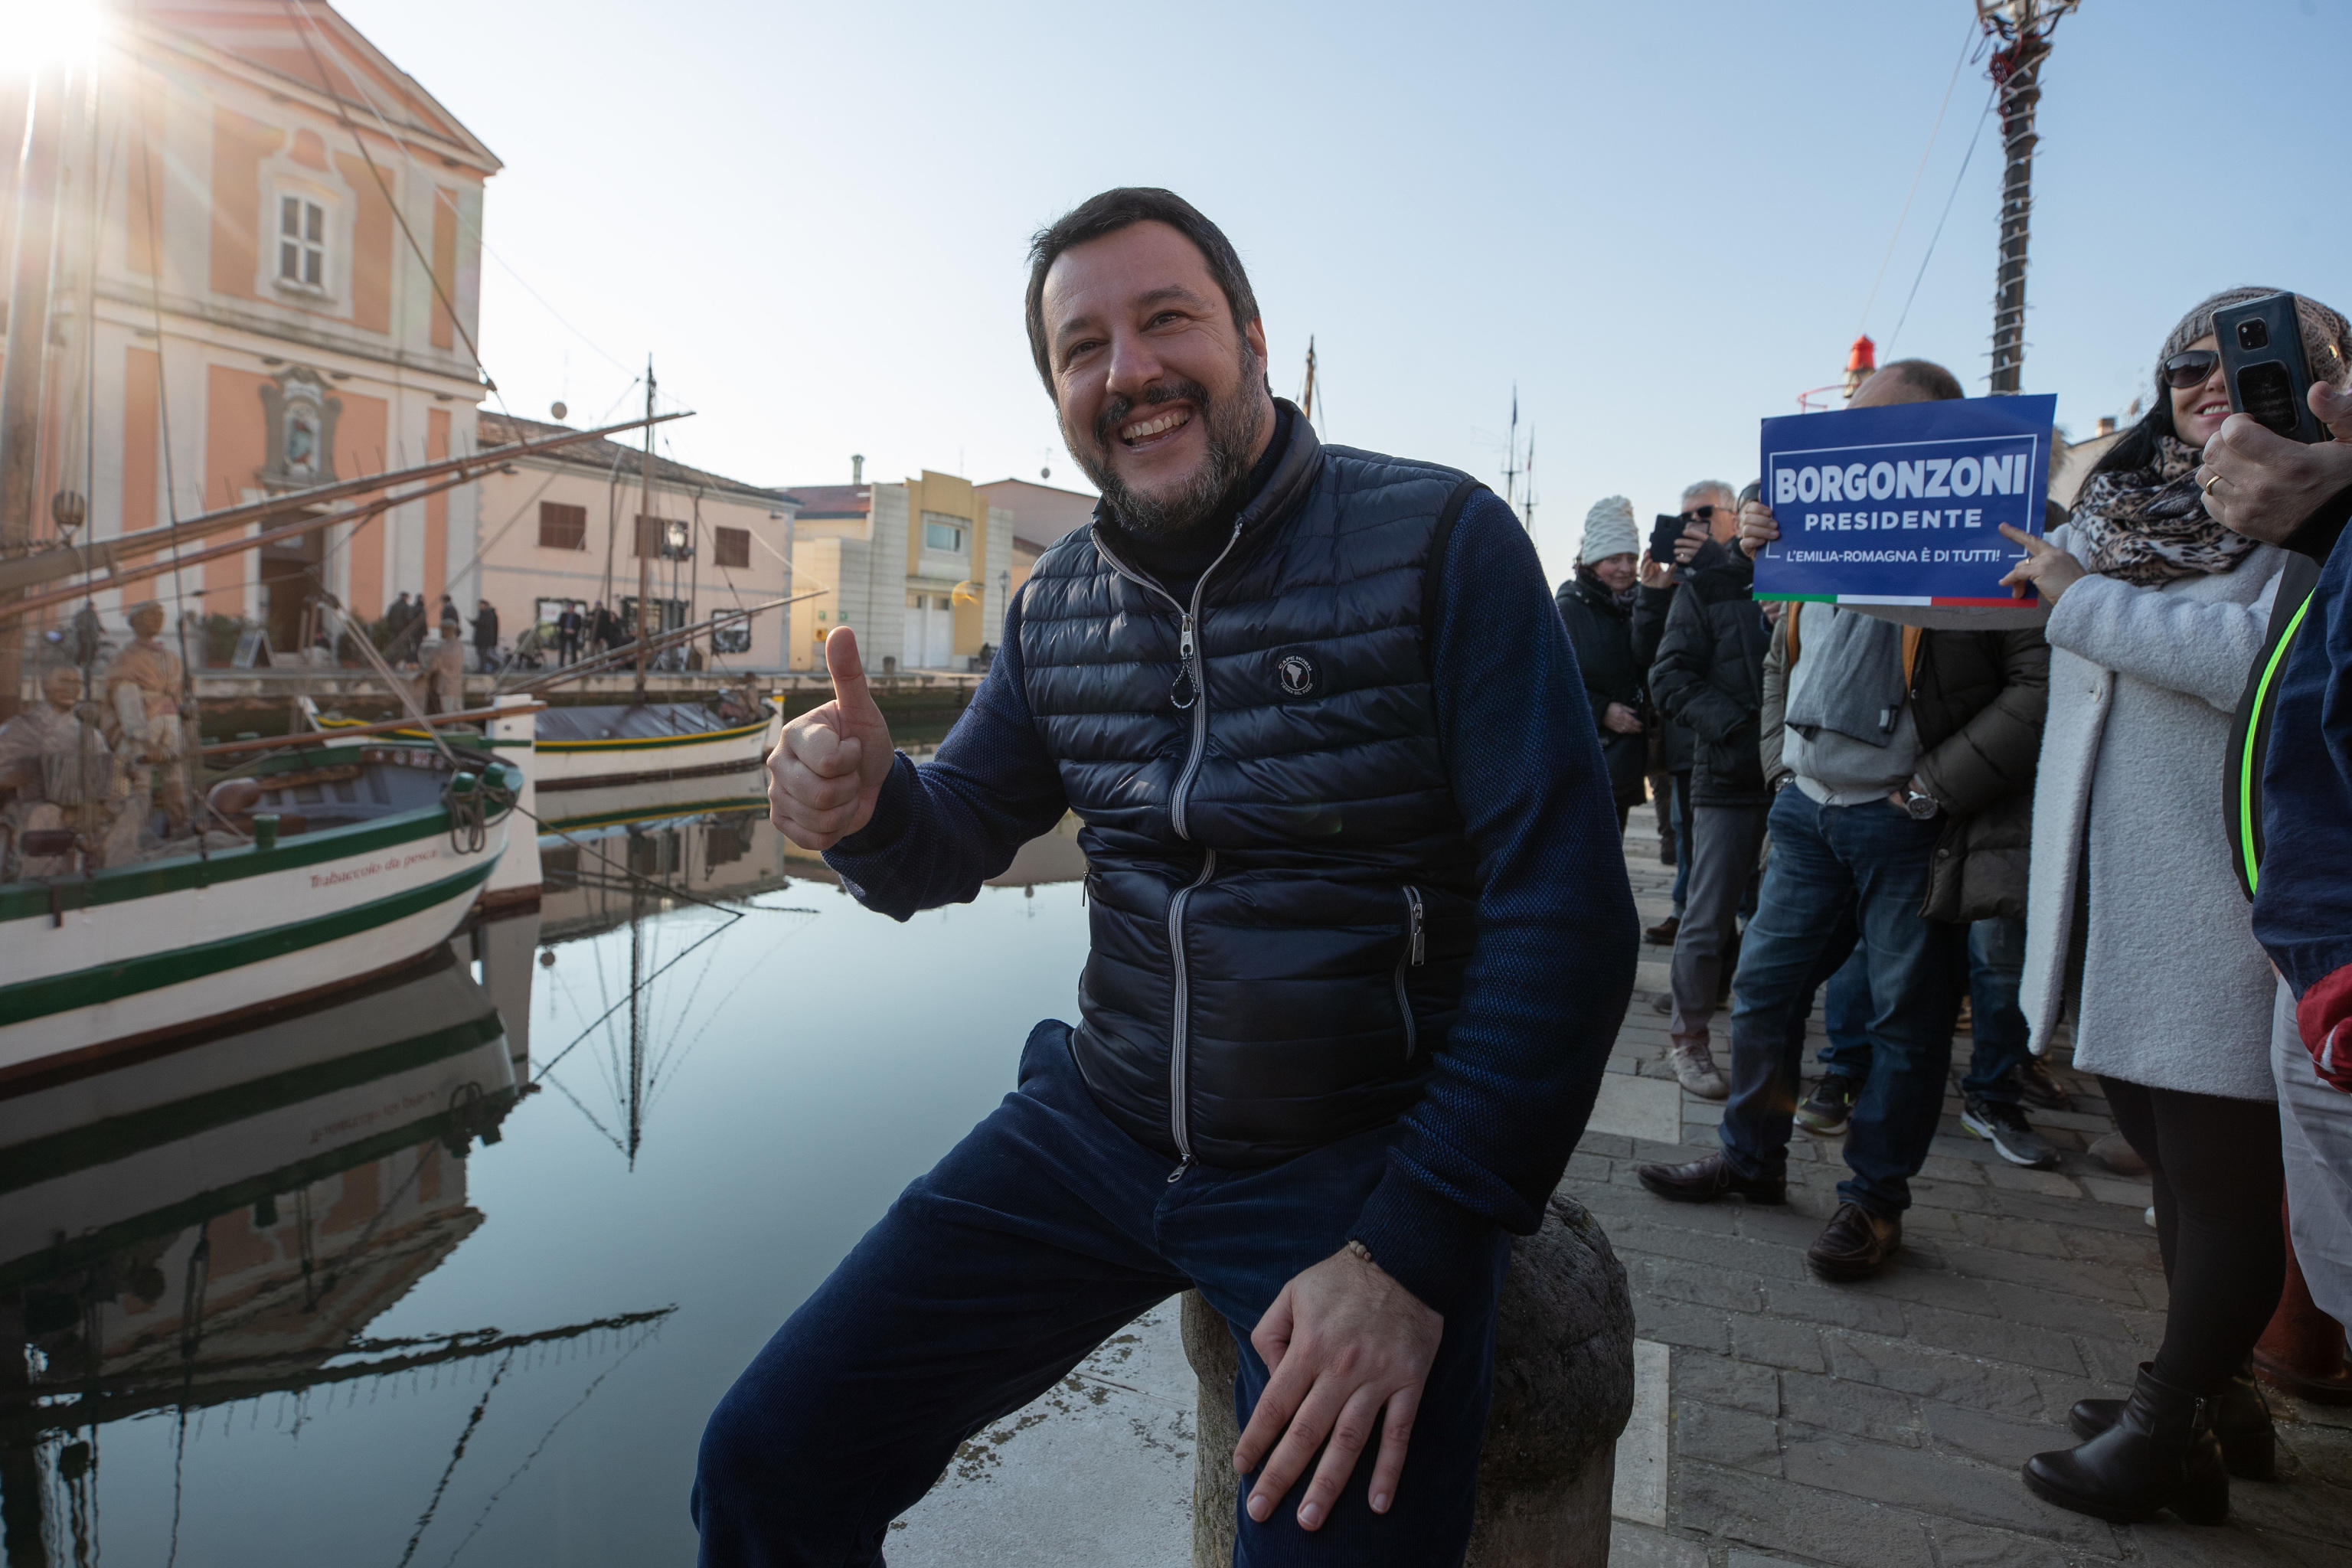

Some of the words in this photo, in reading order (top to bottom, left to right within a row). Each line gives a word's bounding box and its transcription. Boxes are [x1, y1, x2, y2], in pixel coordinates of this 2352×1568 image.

[1775, 453, 2027, 505] BORGONZONI
[1805, 508, 1982, 531] PRESIDENTE
[1786, 550, 1918, 563] L'EMILIA-ROMAGNA
[1921, 546, 1931, 563] È
[1934, 550, 1949, 563] DI
[1952, 550, 2001, 563] TUTTI!
[1279, 656, 1295, 669] CAPE
[1295, 656, 1312, 671] HORN
[310, 861, 382, 888] Trabaccolo
[384, 857, 400, 871] da
[403, 849, 438, 867] pesca
